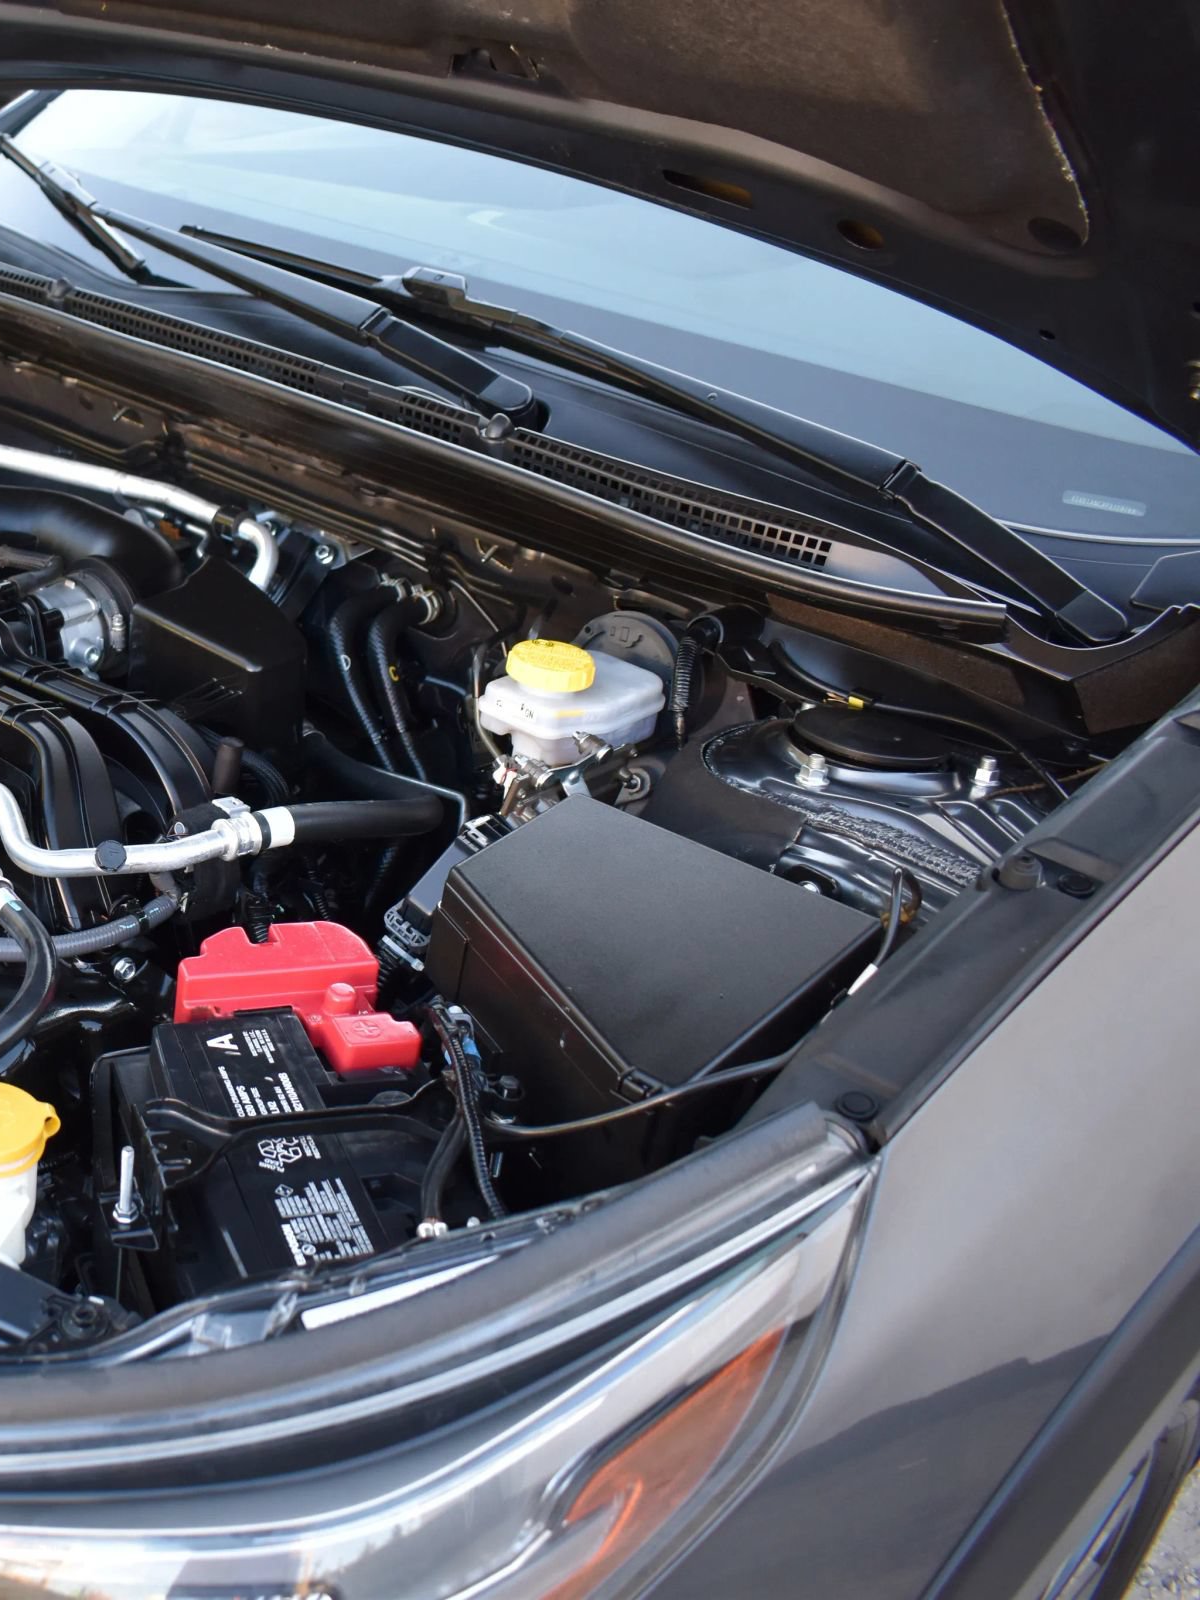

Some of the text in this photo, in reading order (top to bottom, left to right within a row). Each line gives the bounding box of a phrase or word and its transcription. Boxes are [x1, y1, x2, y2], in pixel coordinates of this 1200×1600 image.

[206, 1033, 239, 1050] A
[218, 1066, 229, 1081] AMPS
[236, 1085, 252, 1104] AMPS
[234, 1103, 245, 1117] COLD
[255, 1098, 268, 1115] GROUP
